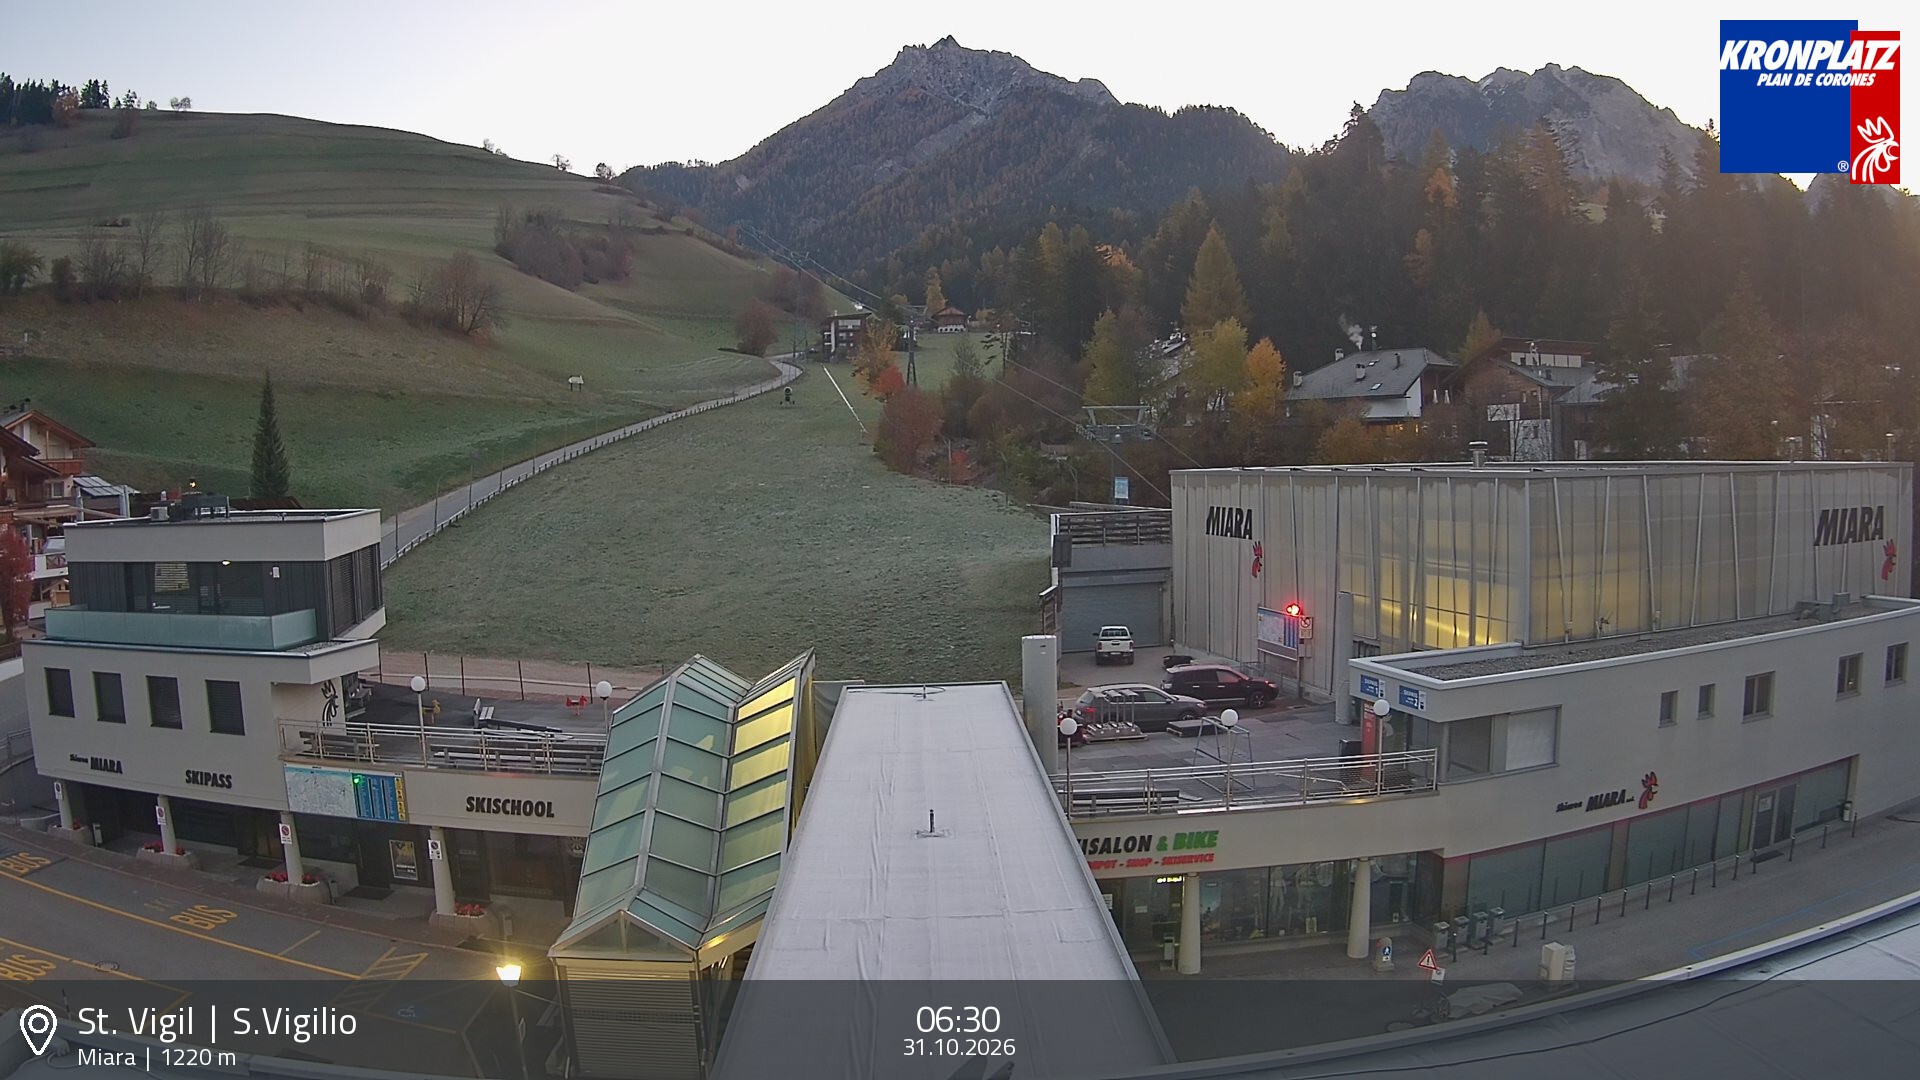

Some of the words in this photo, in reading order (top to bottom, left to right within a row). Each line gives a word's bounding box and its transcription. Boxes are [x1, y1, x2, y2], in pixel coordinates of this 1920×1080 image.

[1206, 506, 1253, 540] MIARA
[1814, 505, 1884, 546] MIARA
[90, 756, 123, 774] MIARA
[185, 769, 233, 789] SKIPASS
[466, 796, 555, 818] SKISCHOOL
[1585, 789, 1626, 812] MIARA
[1156, 836, 1168, 851] &
[1173, 830, 1219, 850] BIKE
[0, 852, 52, 874] BUS
[170, 904, 238, 931] BUS
